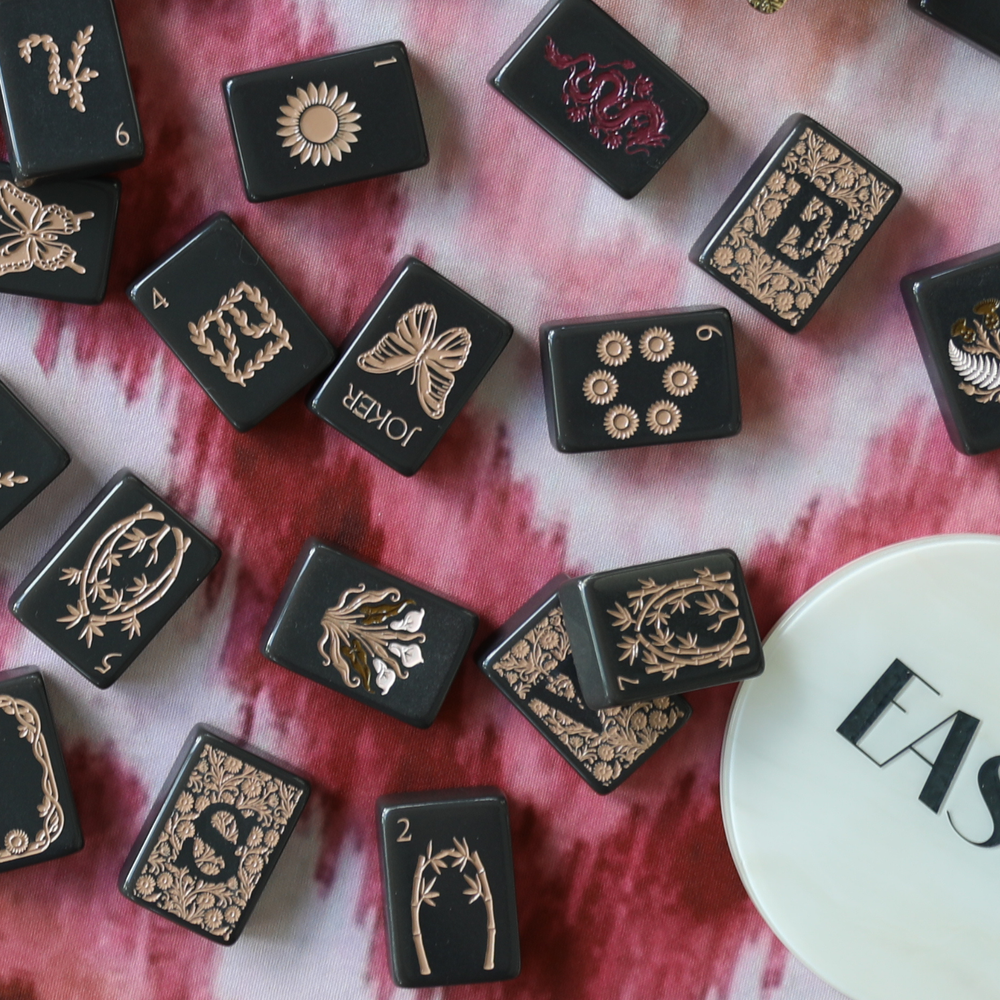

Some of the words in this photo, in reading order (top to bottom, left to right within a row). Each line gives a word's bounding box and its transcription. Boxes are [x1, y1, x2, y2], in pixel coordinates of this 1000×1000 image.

[151, 287, 170, 309] 4
[342, 382, 422, 447] JOKER
[94, 652, 123, 674] 5
[836, 657, 1000, 848] EAS
[395, 817, 413, 843] 2
